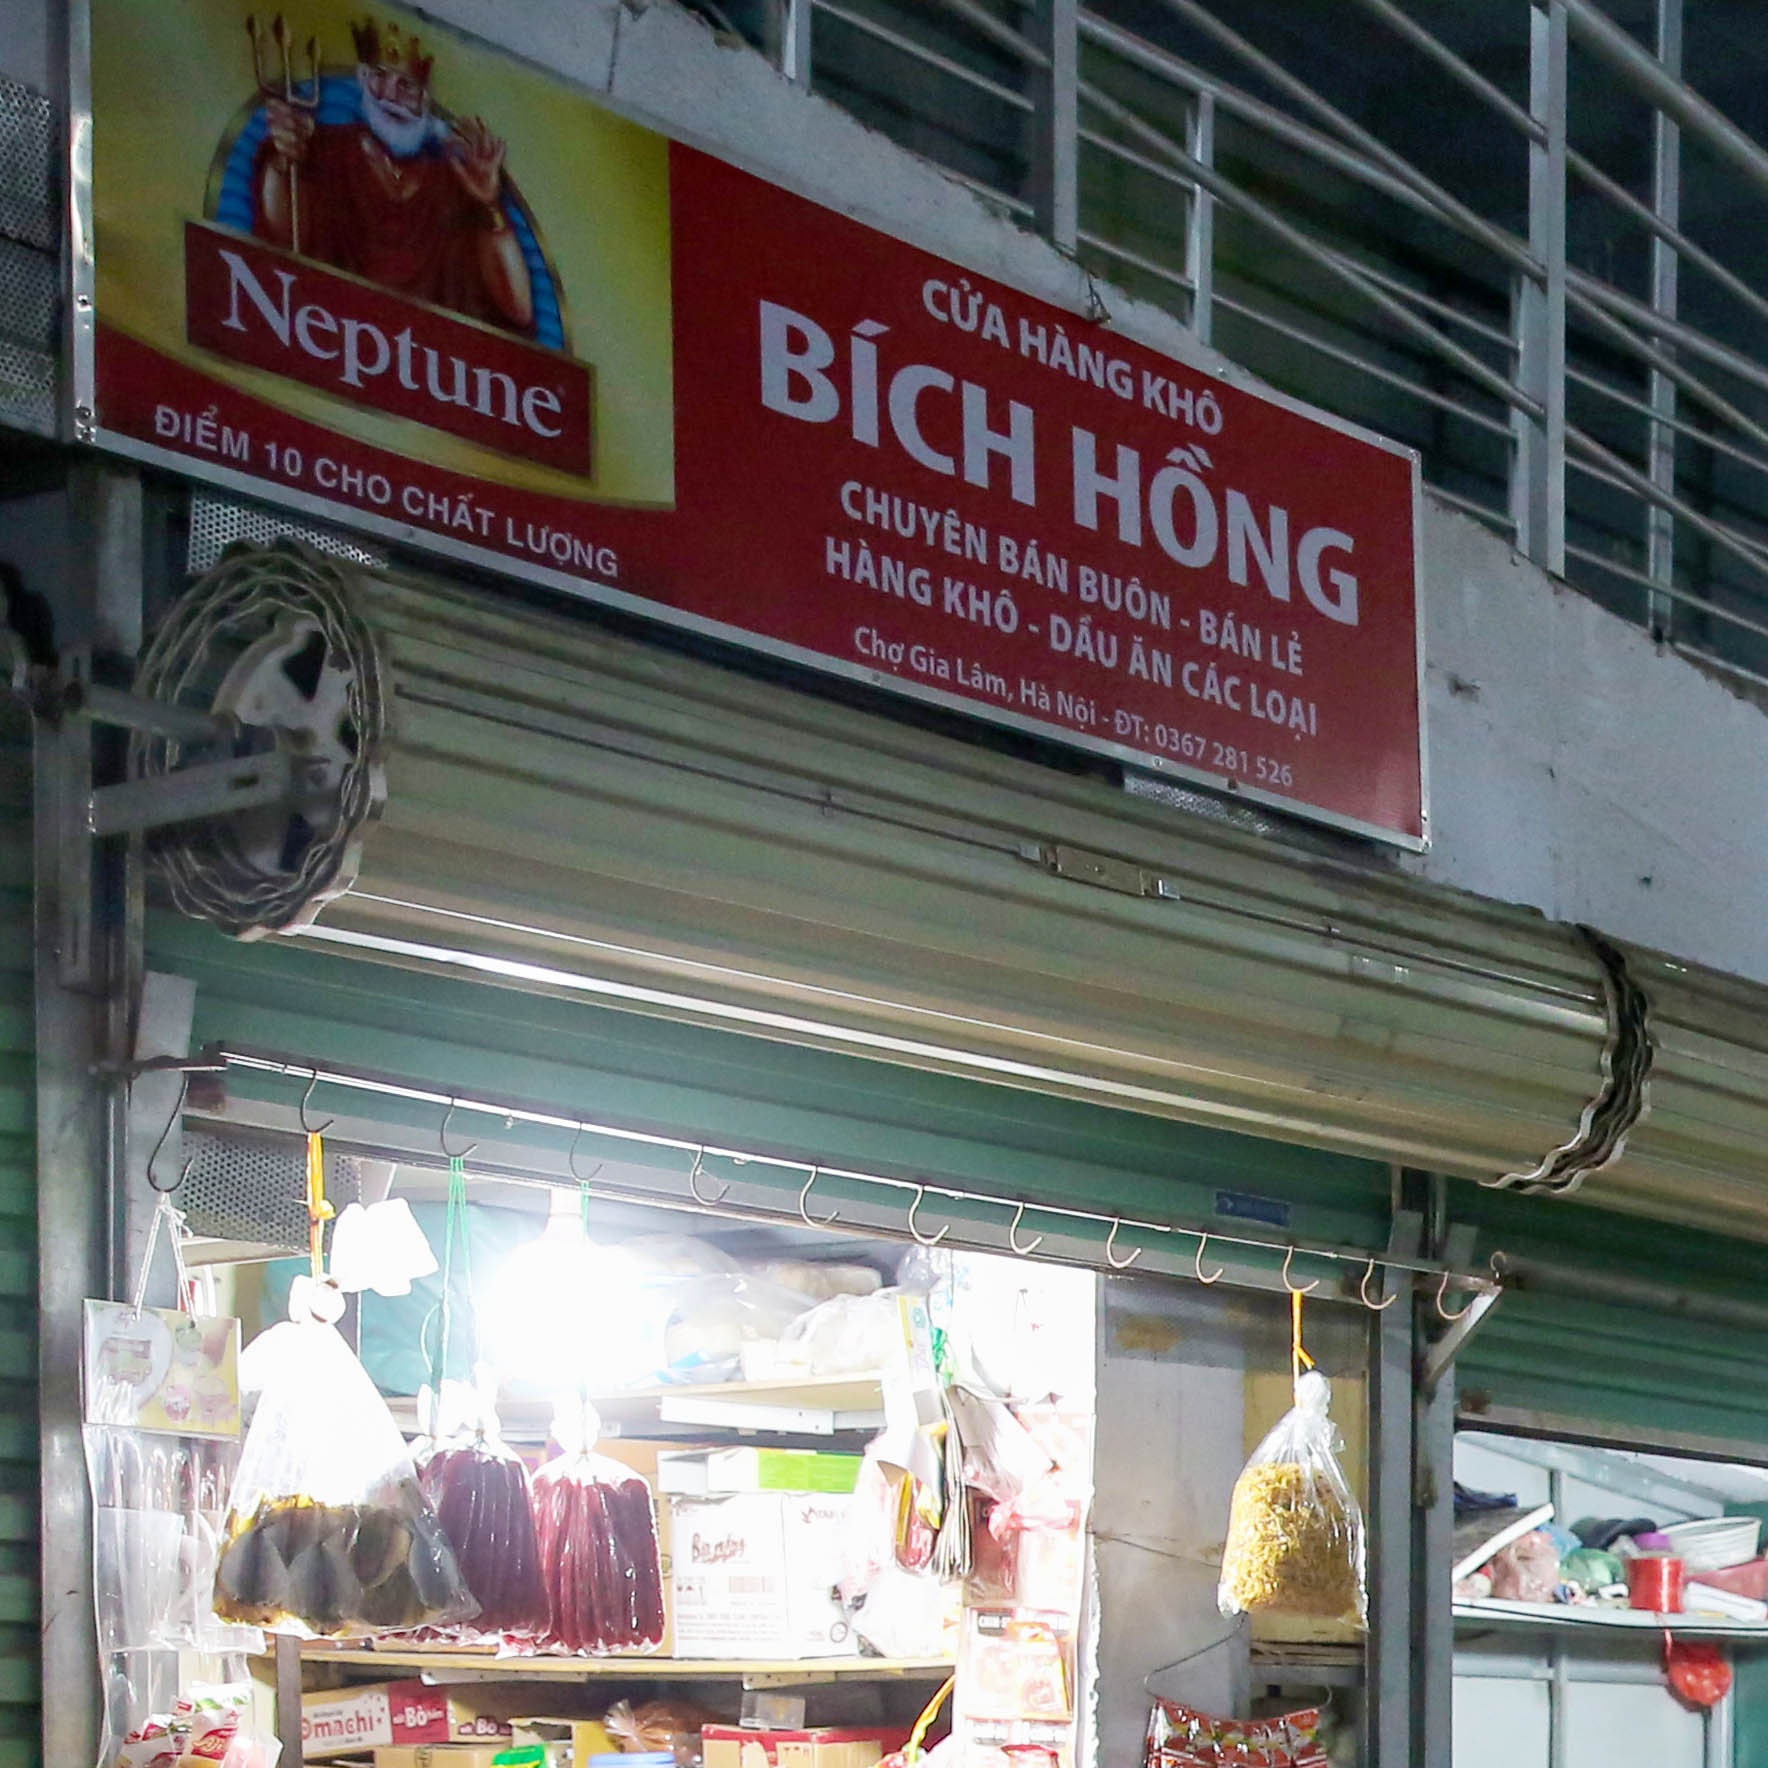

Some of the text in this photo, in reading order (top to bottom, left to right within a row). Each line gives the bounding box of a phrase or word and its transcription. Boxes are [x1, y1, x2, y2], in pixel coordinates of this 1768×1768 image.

[218, 249, 563, 438] Neptune
[923, 278, 1224, 437] CỬA HÀNG KHÔ
[153, 404, 619, 579] ĐIỂM 10 CHO CHẤT LƯỢNG
[759, 299, 1360, 627] BÍCH HỒNG
[826, 536, 932, 606] HÀNG
[943, 580, 1019, 635] KHÔ
[1049, 614, 1118, 669] DẦU
[1128, 634, 1172, 689] ĂN
[1181, 659, 1241, 712] CÁC
[1250, 688, 1318, 740] LOẠI
[840, 480, 988, 566] CHUYÊN
[999, 533, 1067, 594] BÁN
[1079, 565, 1170, 632] BUÔN
[1200, 607, 1261, 664] BÁN
[1270, 630, 1304, 677] LẺ
[854, 625, 905, 664] Chợ
[910, 642, 950, 679] Gia
[957, 655, 1011, 702] Lâm,
[1020, 679, 1052, 714] Hà
[1057, 687, 1097, 731] Nội
[1114, 709, 1150, 744] ĐT:
[1155, 723, 1206, 760] 0367
[1212, 738, 1249, 775] 281
[1255, 751, 1293, 788] 526
